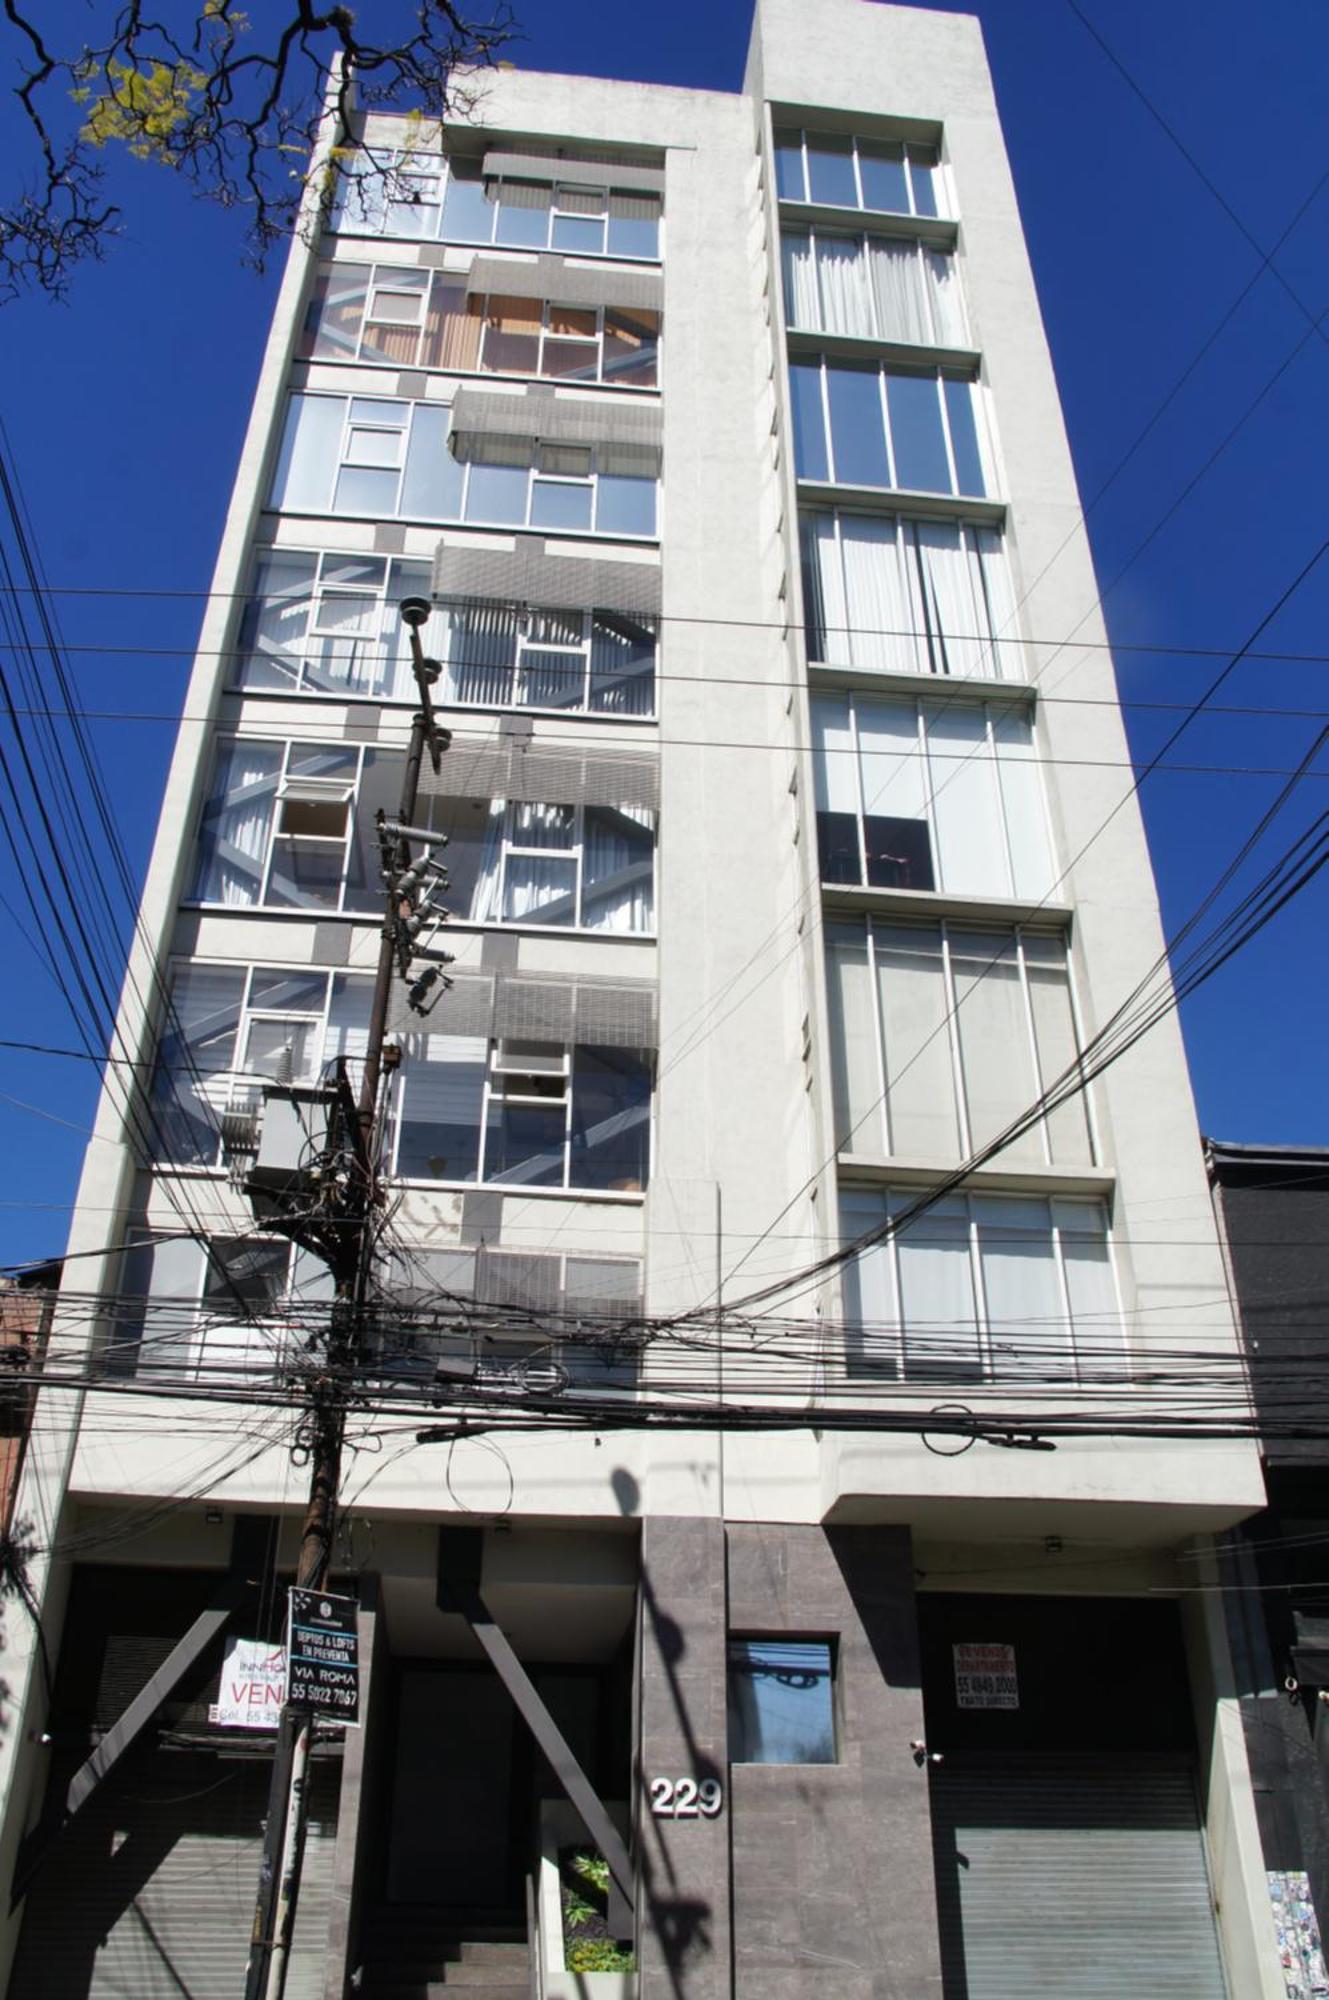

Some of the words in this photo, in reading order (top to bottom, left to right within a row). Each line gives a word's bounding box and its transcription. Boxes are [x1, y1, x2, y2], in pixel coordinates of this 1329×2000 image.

[332, 1637, 355, 1650] LOFTS
[294, 1665, 315, 1679] VIA
[319, 1669, 356, 1685] ROMA
[231, 1681, 285, 1705] VEN
[291, 1682, 306, 1699] 55
[651, 1777, 722, 1818] 229
